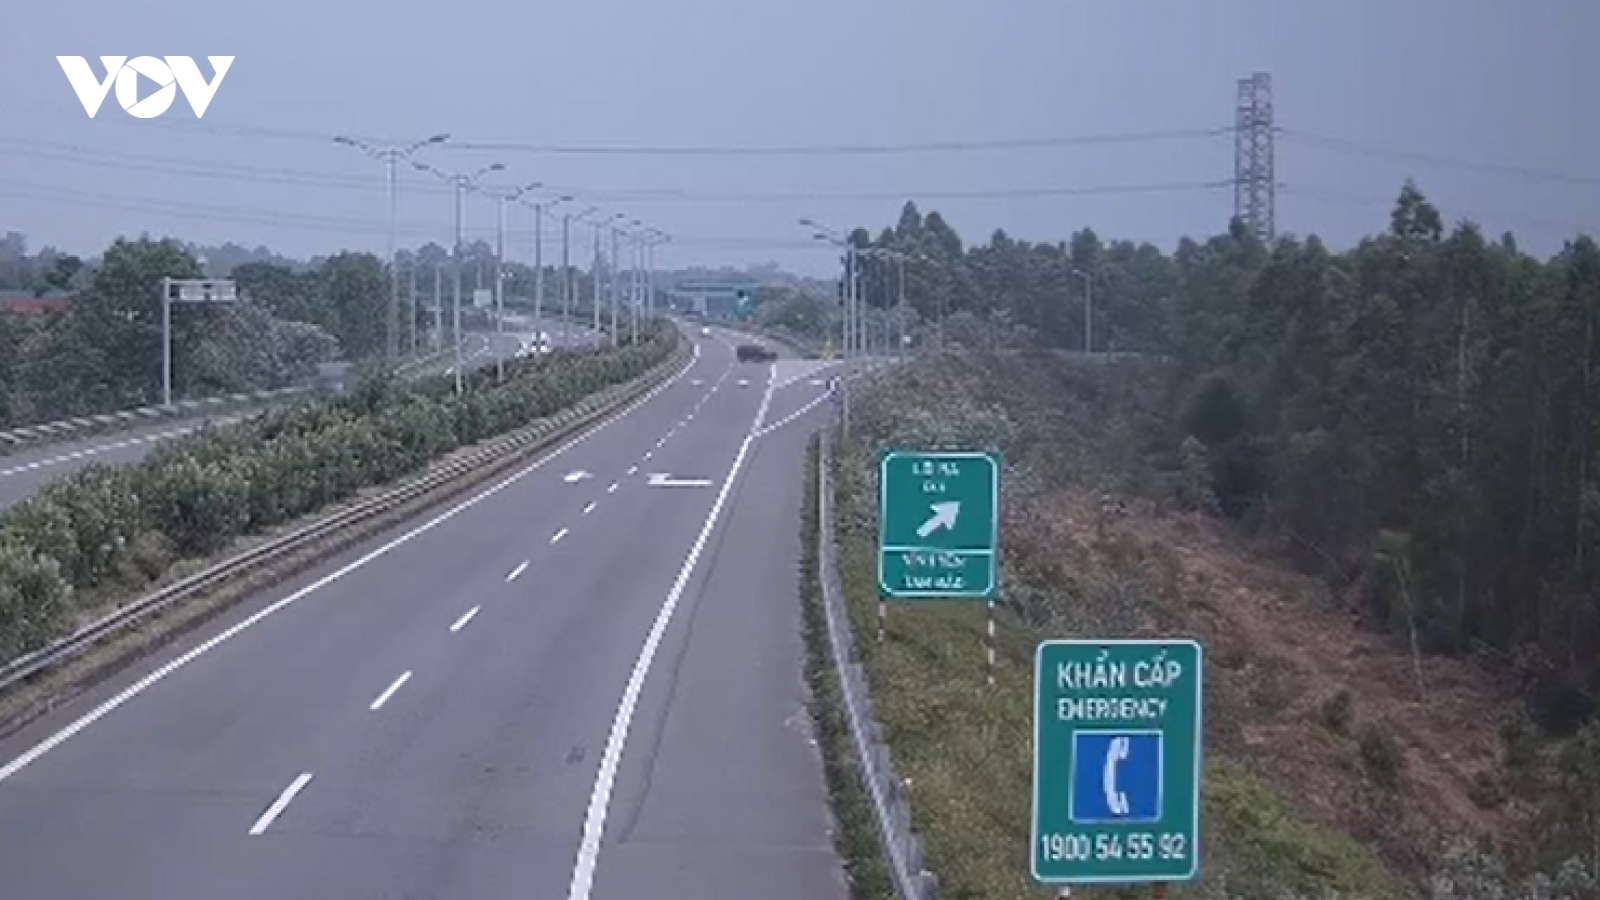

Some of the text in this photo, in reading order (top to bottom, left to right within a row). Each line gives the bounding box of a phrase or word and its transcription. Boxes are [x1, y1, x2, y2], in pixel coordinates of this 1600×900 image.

[1056, 649, 1182, 688] KHẢN CẤP
[1057, 697, 1169, 720] EMERGENCY
[1041, 832, 1187, 861] 1900 54 55 92
